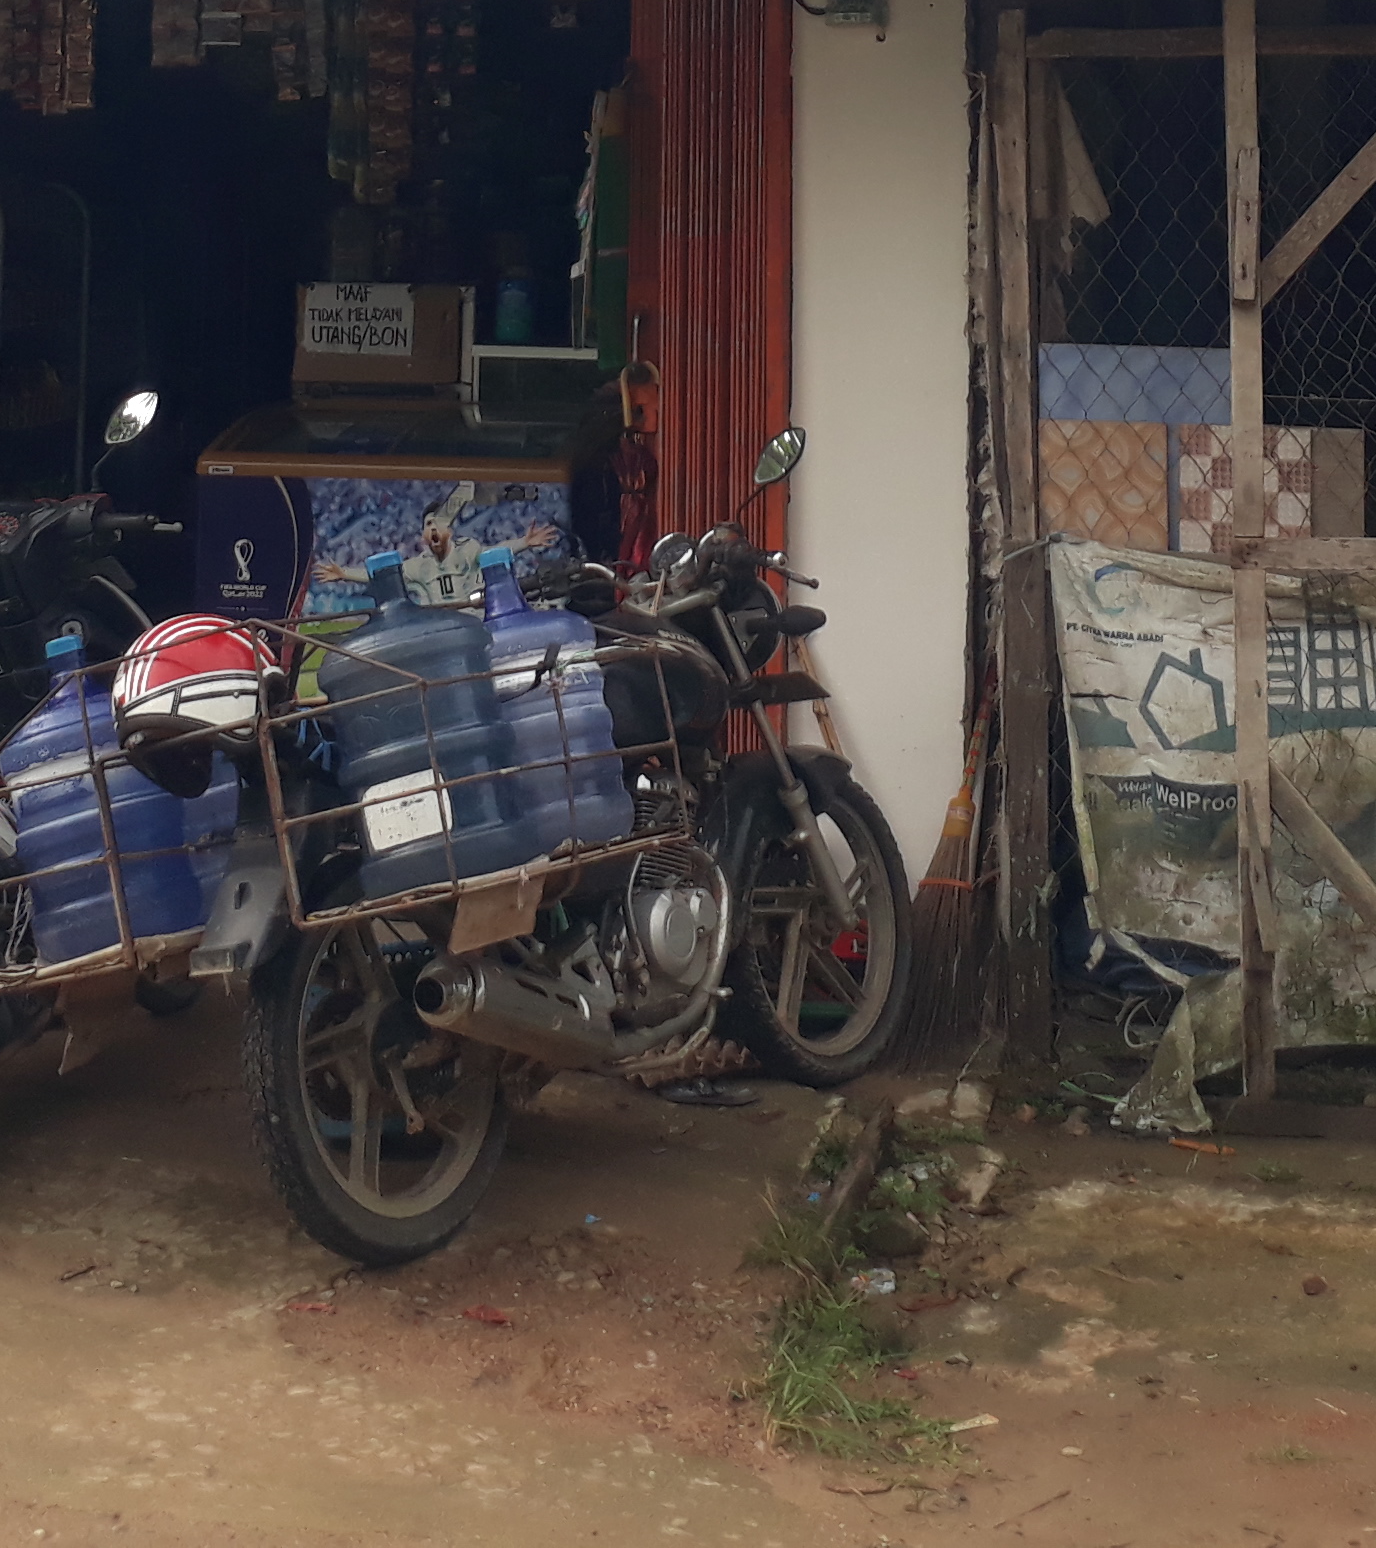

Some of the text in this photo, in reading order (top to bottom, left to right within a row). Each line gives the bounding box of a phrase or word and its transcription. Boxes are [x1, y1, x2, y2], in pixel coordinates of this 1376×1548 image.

[336, 284, 373, 303] MAAF
[308, 307, 343, 323] TIDAK
[436, 574, 455, 596] 10
[1155, 781, 1237, 812] WelProo
